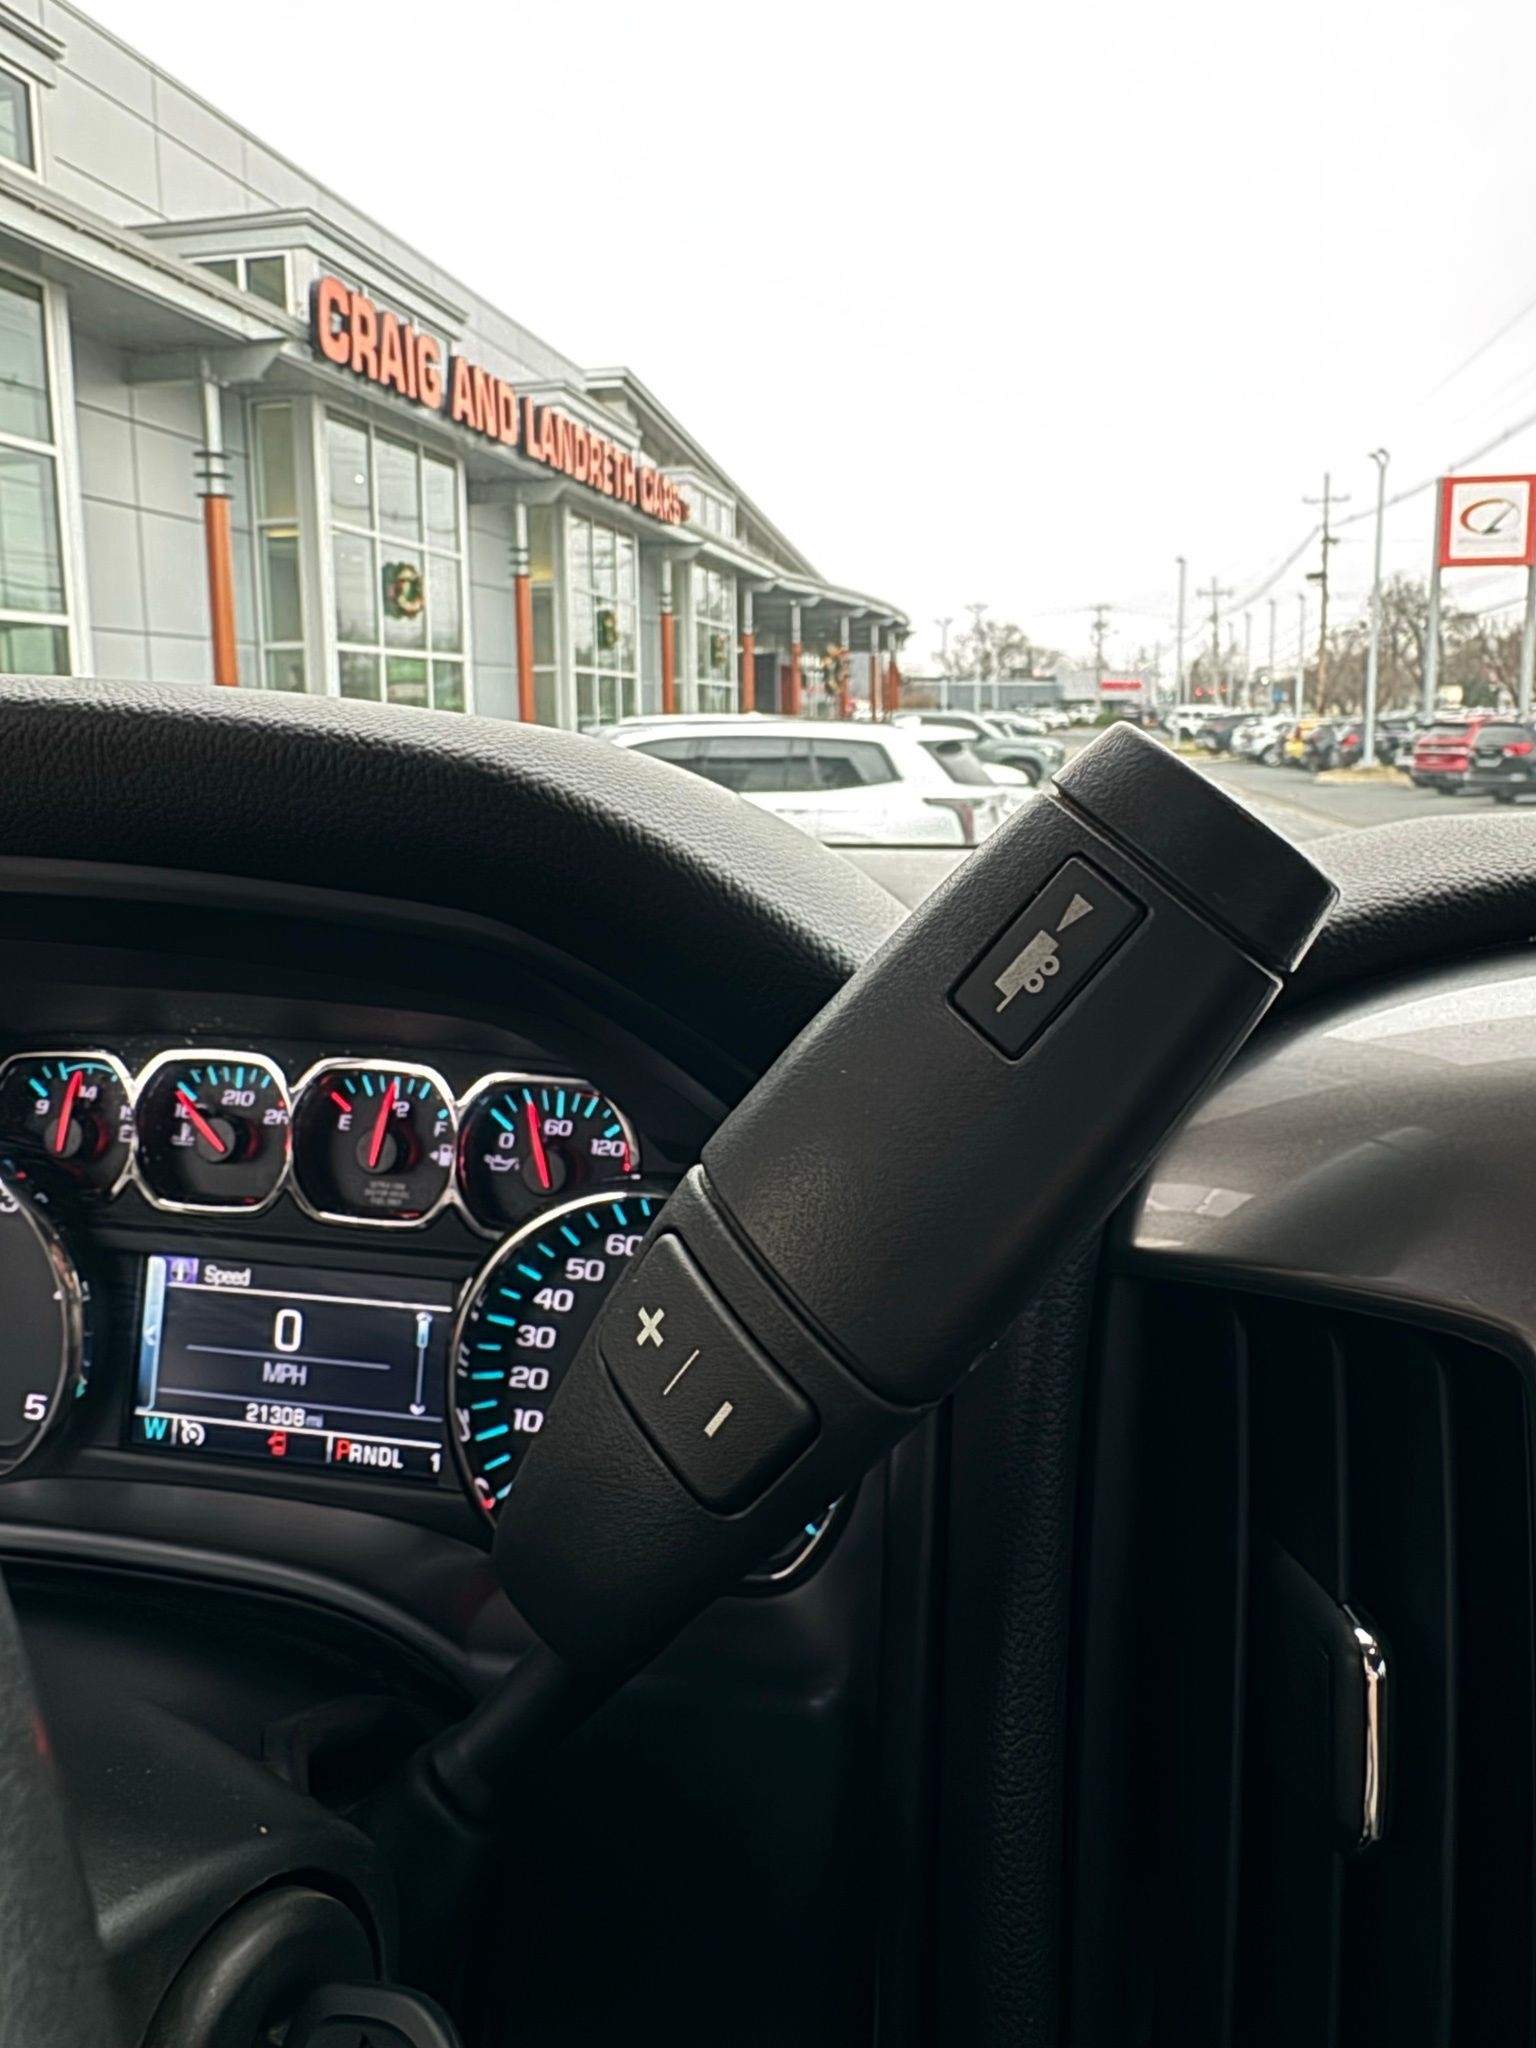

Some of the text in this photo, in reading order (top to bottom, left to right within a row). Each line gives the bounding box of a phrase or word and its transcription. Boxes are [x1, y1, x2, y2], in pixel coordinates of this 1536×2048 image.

[312, 275, 443, 410] CRAIG
[449, 356, 519, 447] AND
[522, 396, 637, 507] LANDRETH
[35, 1100, 49, 1115] 9
[221, 1089, 255, 1107] 210
[337, 1114, 353, 1131] E
[433, 1122, 448, 1137] F
[543, 1119, 573, 1137] 60
[499, 1132, 515, 1149] 0
[590, 1137, 627, 1157] 120
[203, 1263, 251, 1287] Speed
[565, 1258, 606, 1282] 50
[533, 1288, 575, 1313] 40
[273, 1308, 302, 1352] 0
[515, 1325, 557, 1350] 30
[262, 1361, 307, 1386] MPH
[509, 1366, 549, 1391] 20
[23, 1393, 48, 1421] 5
[245, 1402, 306, 1428] 21308
[143, 1416, 168, 1441] W
[513, 1409, 544, 1434] 10
[335, 1439, 404, 1469] PRNDL
[429, 1452, 441, 1473] 1
